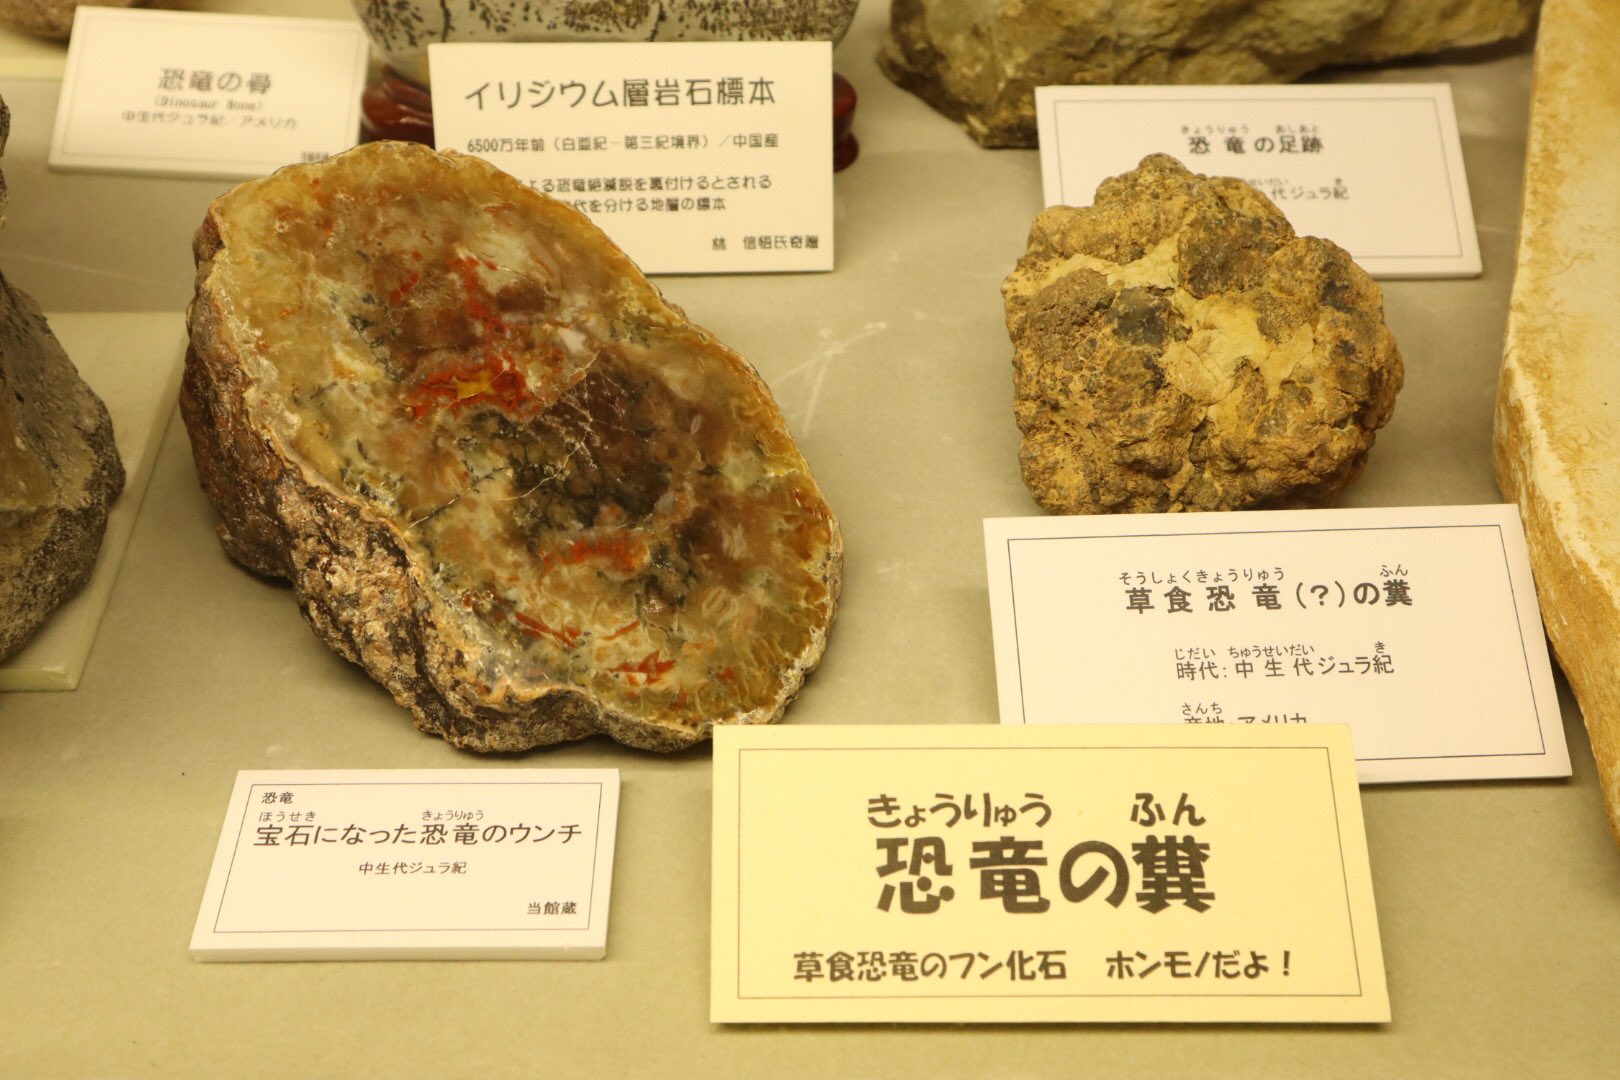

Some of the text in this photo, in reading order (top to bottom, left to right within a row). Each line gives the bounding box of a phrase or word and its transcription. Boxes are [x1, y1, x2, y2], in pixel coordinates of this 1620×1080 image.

[158, 68, 272, 94] 恐竜の骨
[465, 77, 775, 110] イリジウム層岩石標本
[1189, 135, 1323, 155] 恐竜の足跡
[1119, 564, 1408, 586] そうしょくきょうりゅう ふん
[1175, 641, 1386, 661] じだい ちゅうせいだい き
[1182, 702, 1222, 716] さんち
[262, 791, 294, 804] 恐竜
[259, 809, 484, 822] ほうせき きょうりゅう
[868, 792, 1206, 828] きょうりゅう ふん
[253, 822, 582, 846] 宝石になった恐竜のウンチ
[359, 861, 466, 875] 中生代ジュラ紀
[876, 835, 1216, 915] 恐竜の糞
[527, 901, 577, 915] 当館蔵
[794, 950, 1290, 983] 草食恐竜のフン化石 ホンモノだよ！
